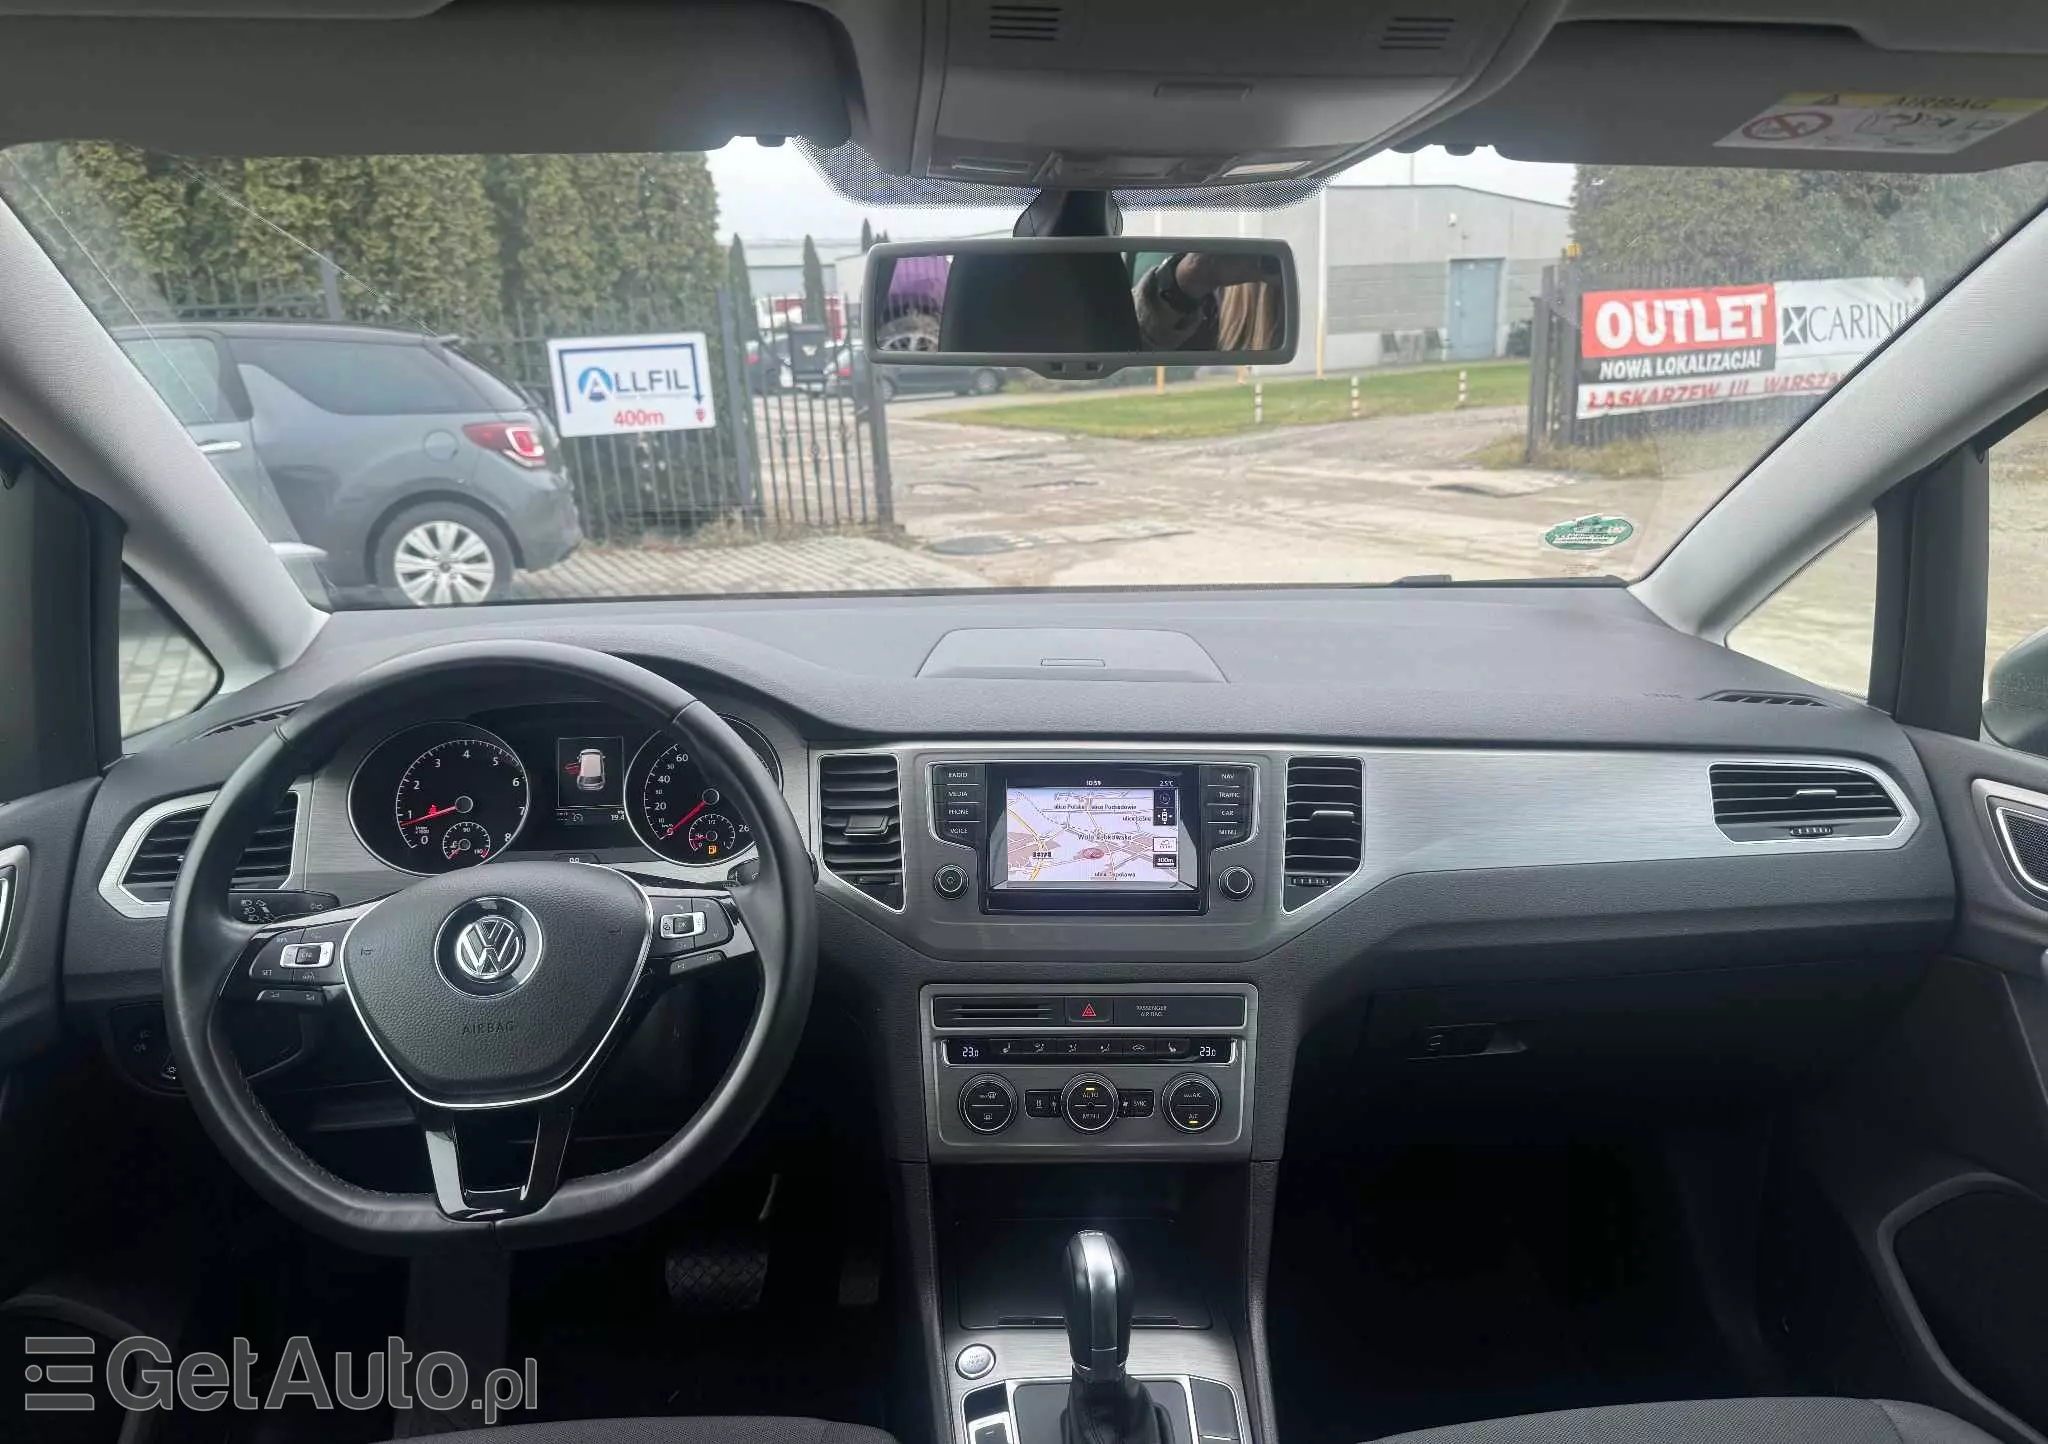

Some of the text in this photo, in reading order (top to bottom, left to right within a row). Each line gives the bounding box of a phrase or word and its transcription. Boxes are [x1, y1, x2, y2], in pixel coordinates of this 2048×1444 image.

[1595, 292, 1768, 349] OUTLET
[1600, 349, 1762, 380] NOWA LOKALIZACJA!
[614, 409, 665, 427] 400m
[463, 749, 471, 759] 4
[676, 754, 689, 762] 60
[434, 758, 441, 768] 3
[492, 756, 499, 766] 5
[512, 777, 520, 787] 6
[657, 775, 671, 783] 40
[413, 780, 420, 790] 2
[654, 802, 667, 811] 20
[462, 1020, 515, 1035] AIRBAG
